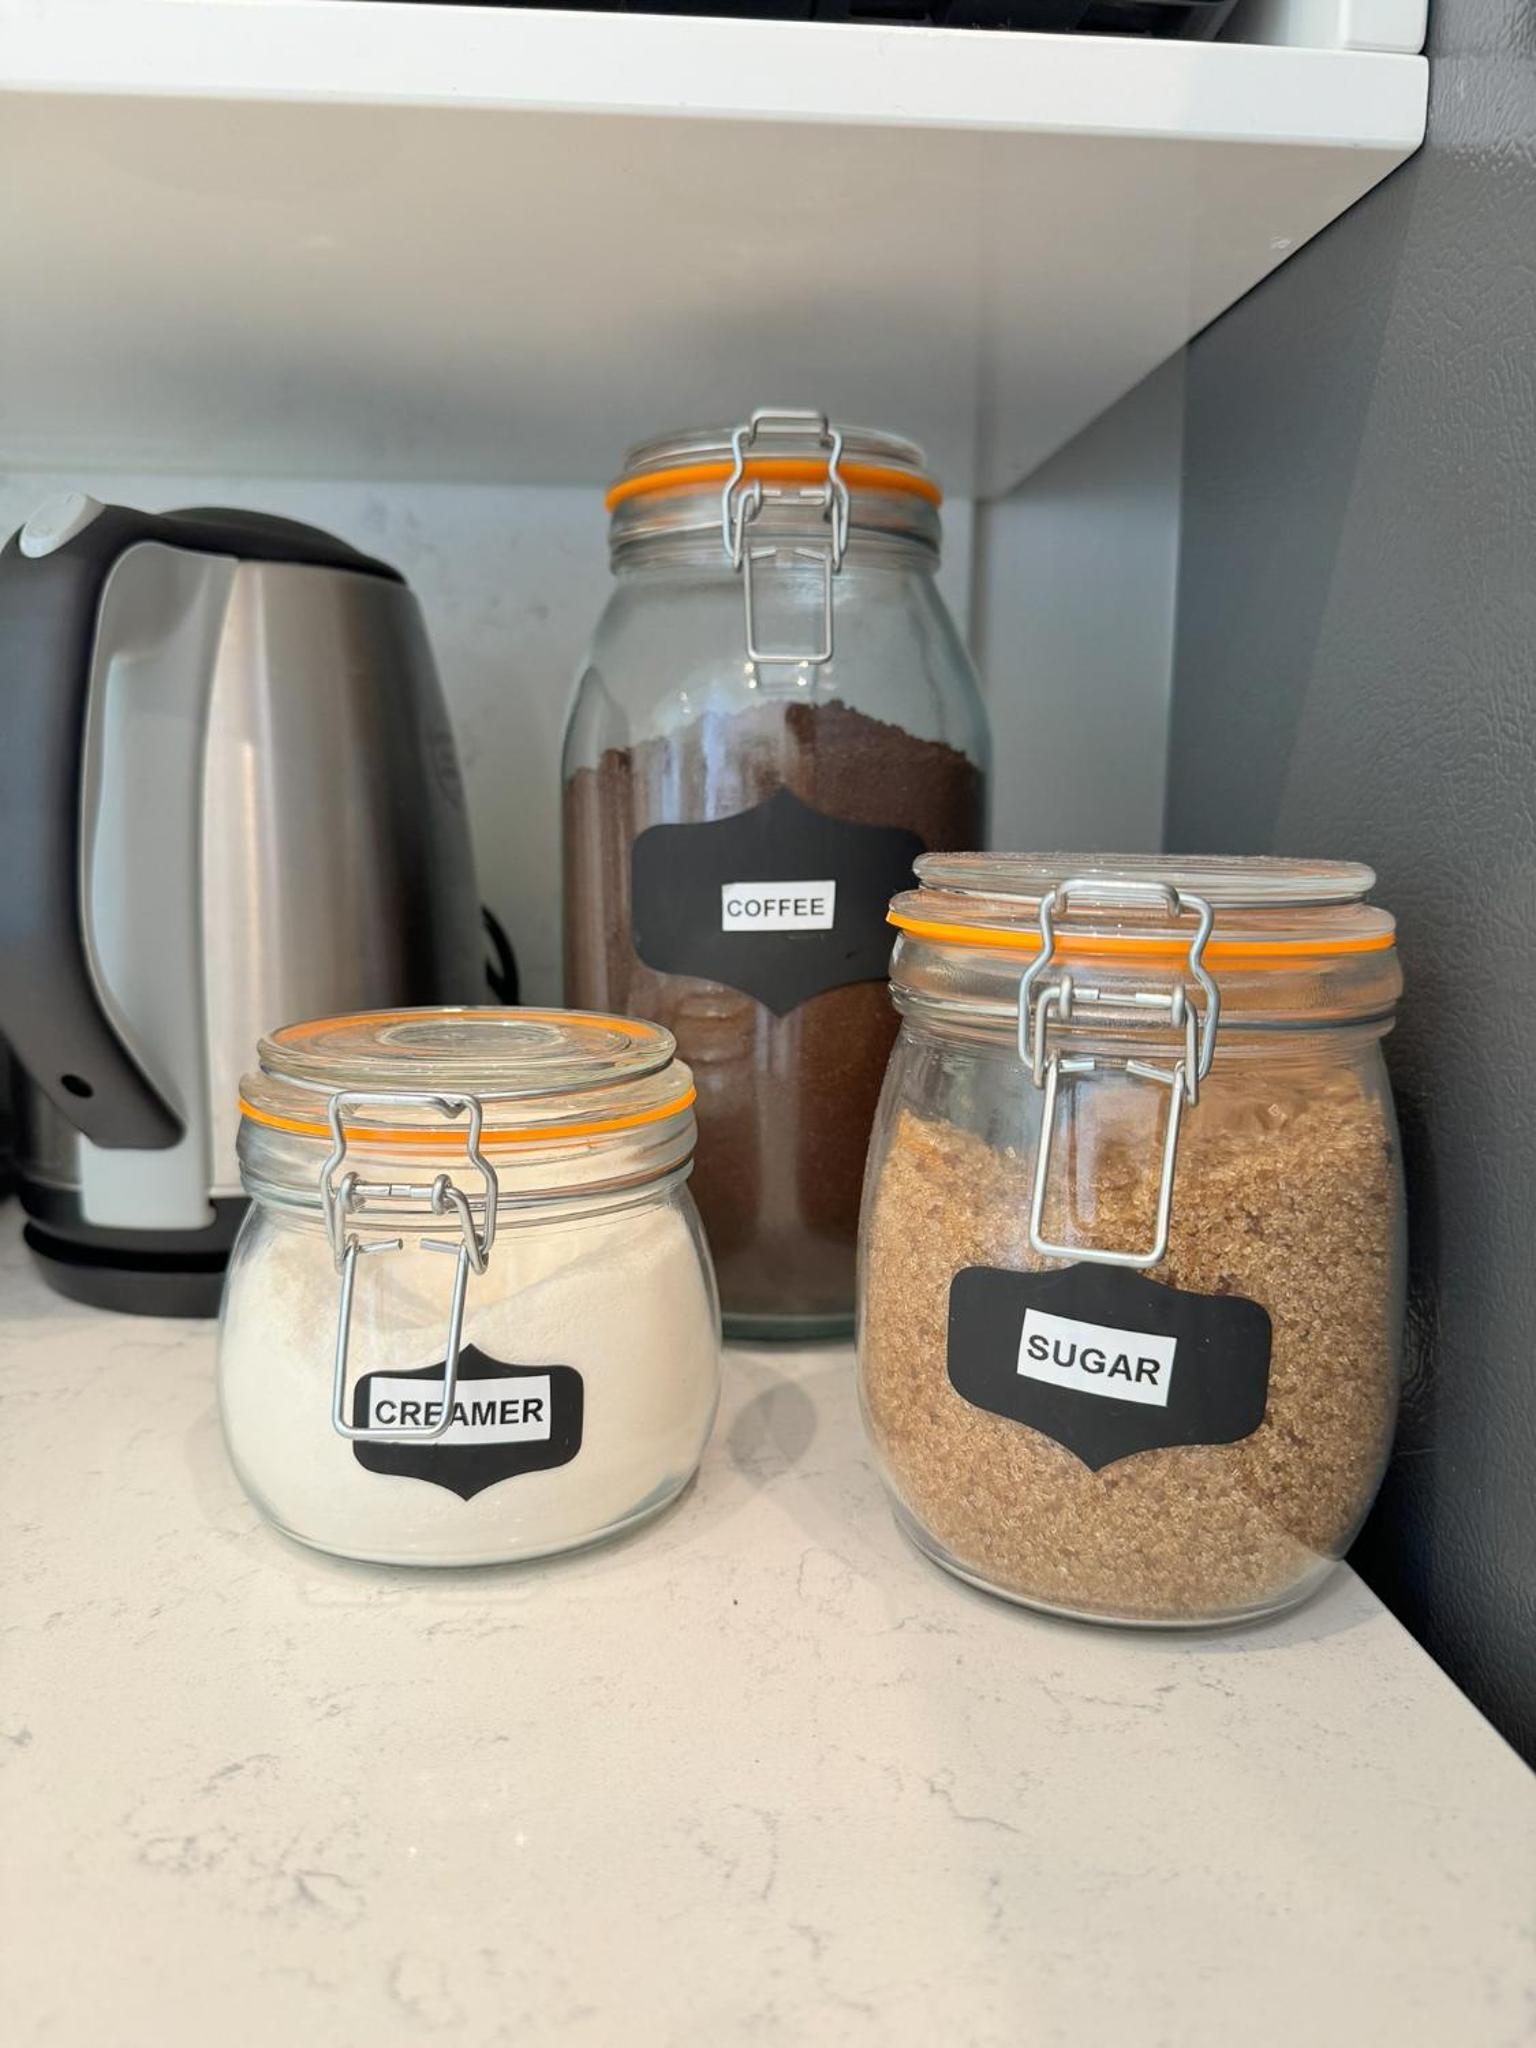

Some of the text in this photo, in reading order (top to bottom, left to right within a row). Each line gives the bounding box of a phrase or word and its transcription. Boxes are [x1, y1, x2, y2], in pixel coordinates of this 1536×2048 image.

[727, 898, 825, 917] COFFEE
[1027, 1334, 1160, 1385] SUGAR
[375, 1398, 544, 1426] CREAMER
